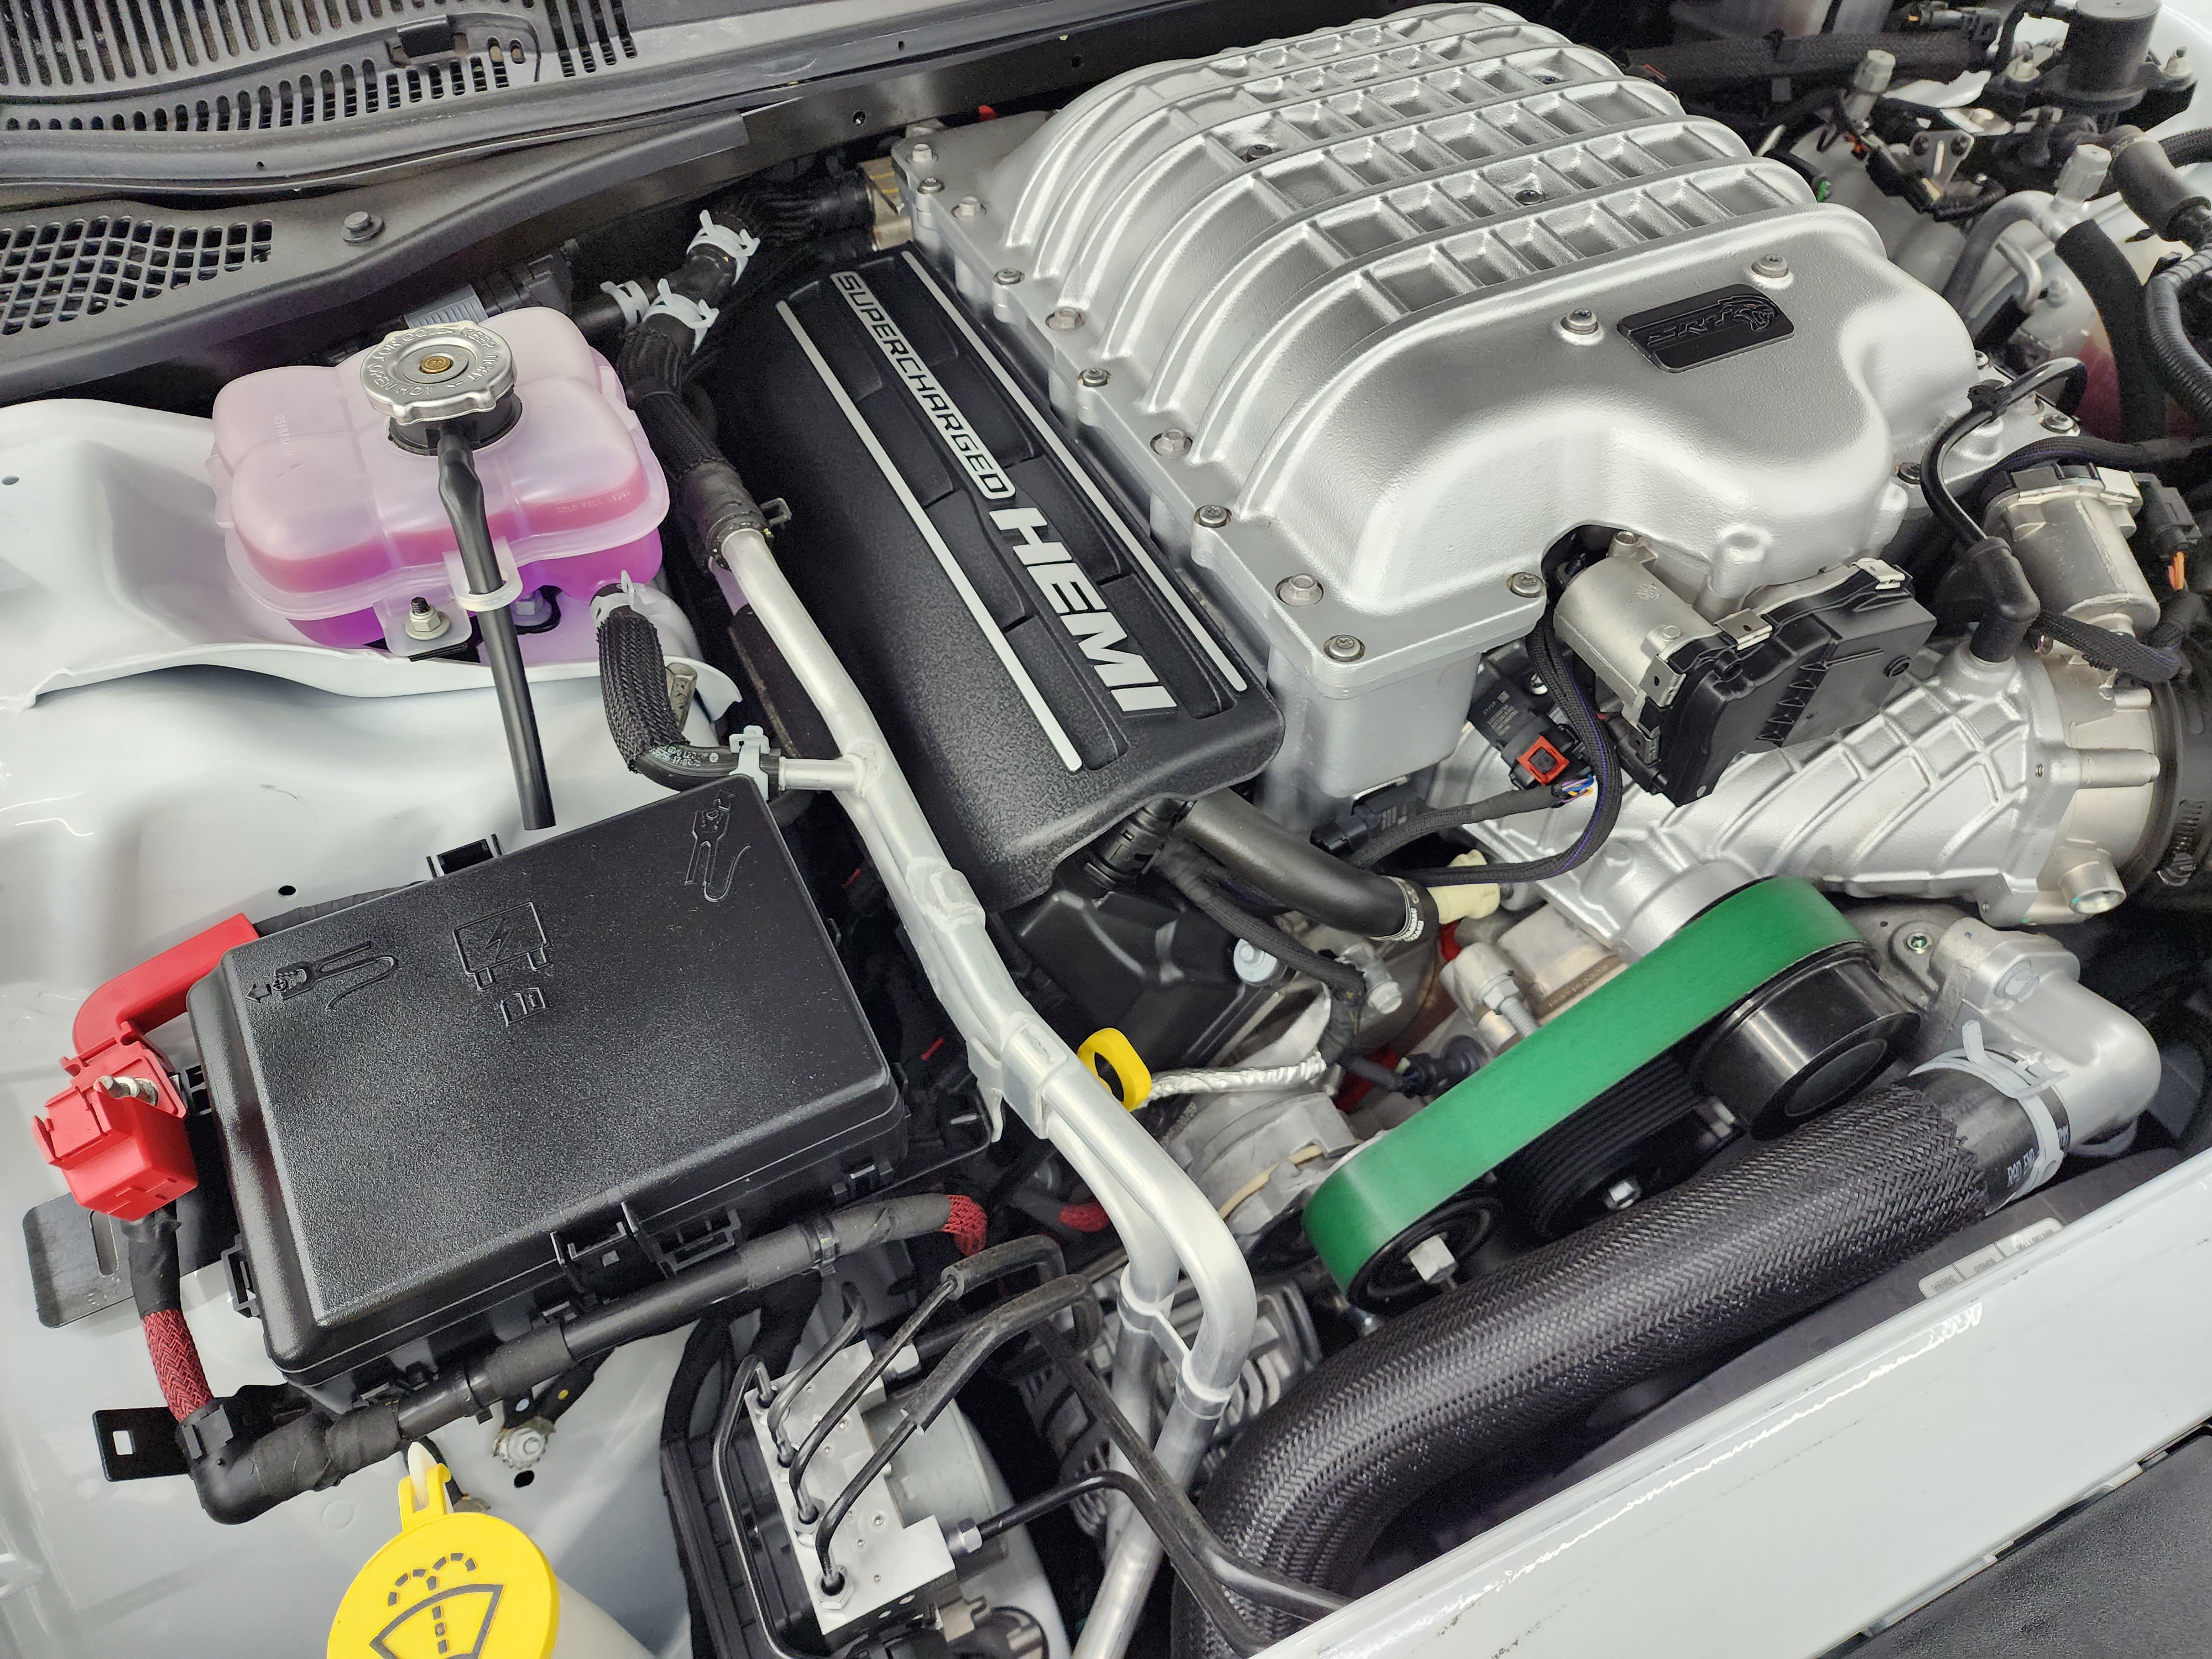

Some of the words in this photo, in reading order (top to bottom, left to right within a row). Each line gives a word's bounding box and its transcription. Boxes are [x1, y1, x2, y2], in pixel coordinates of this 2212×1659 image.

[401, 328, 428, 342] DO
[460, 327, 497, 348] KEEP
[373, 338, 402, 362] NOT
[367, 363, 398, 390] OPEN
[837, 273, 1009, 496] SUPERCHARGED
[989, 507, 1177, 712] HEMI
